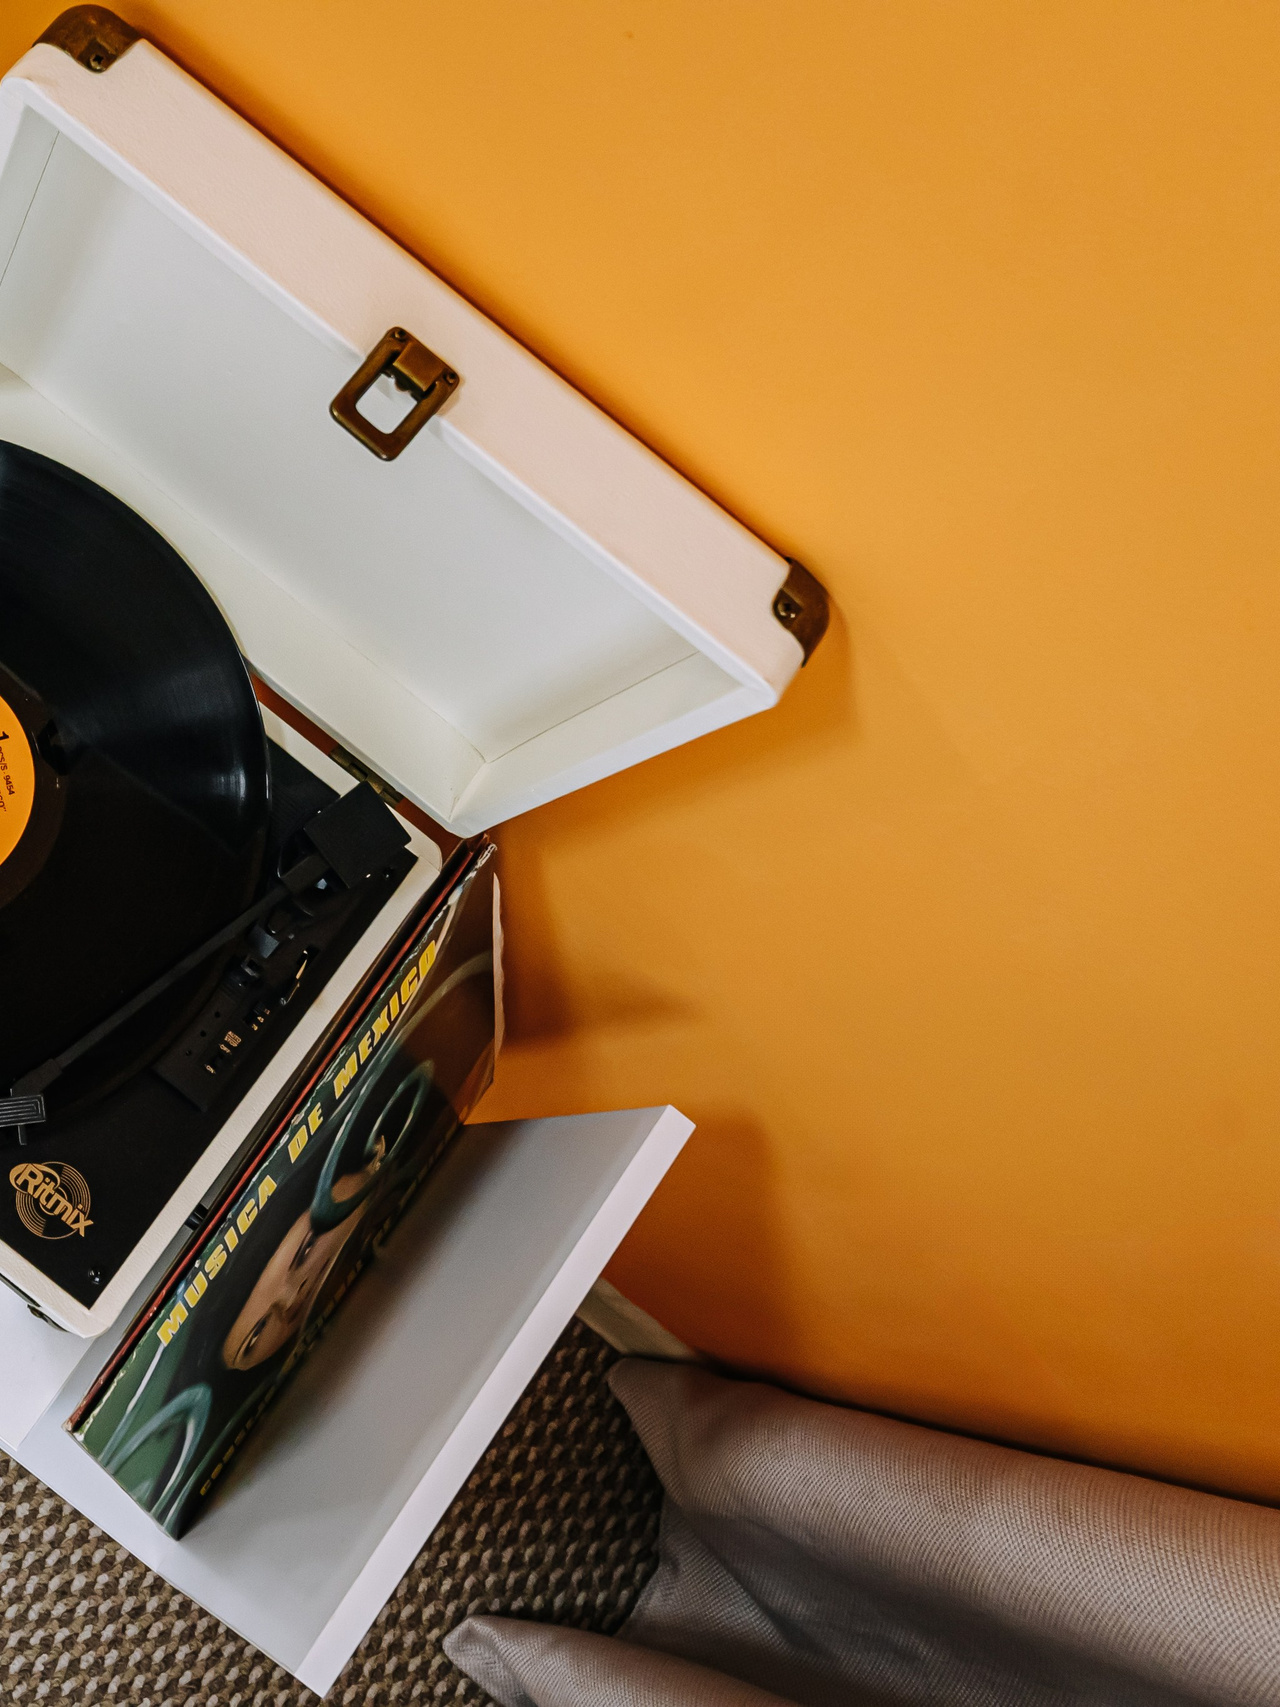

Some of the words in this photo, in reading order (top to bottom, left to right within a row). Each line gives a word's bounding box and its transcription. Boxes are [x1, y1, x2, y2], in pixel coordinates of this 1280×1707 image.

[3, 775, 15, 795] 9454
[157, 1175, 277, 1347] MUSICA
[288, 1102, 326, 1164] DE
[333, 940, 436, 1100] MEXICO
[13, 1163, 94, 1238] Ritmix
